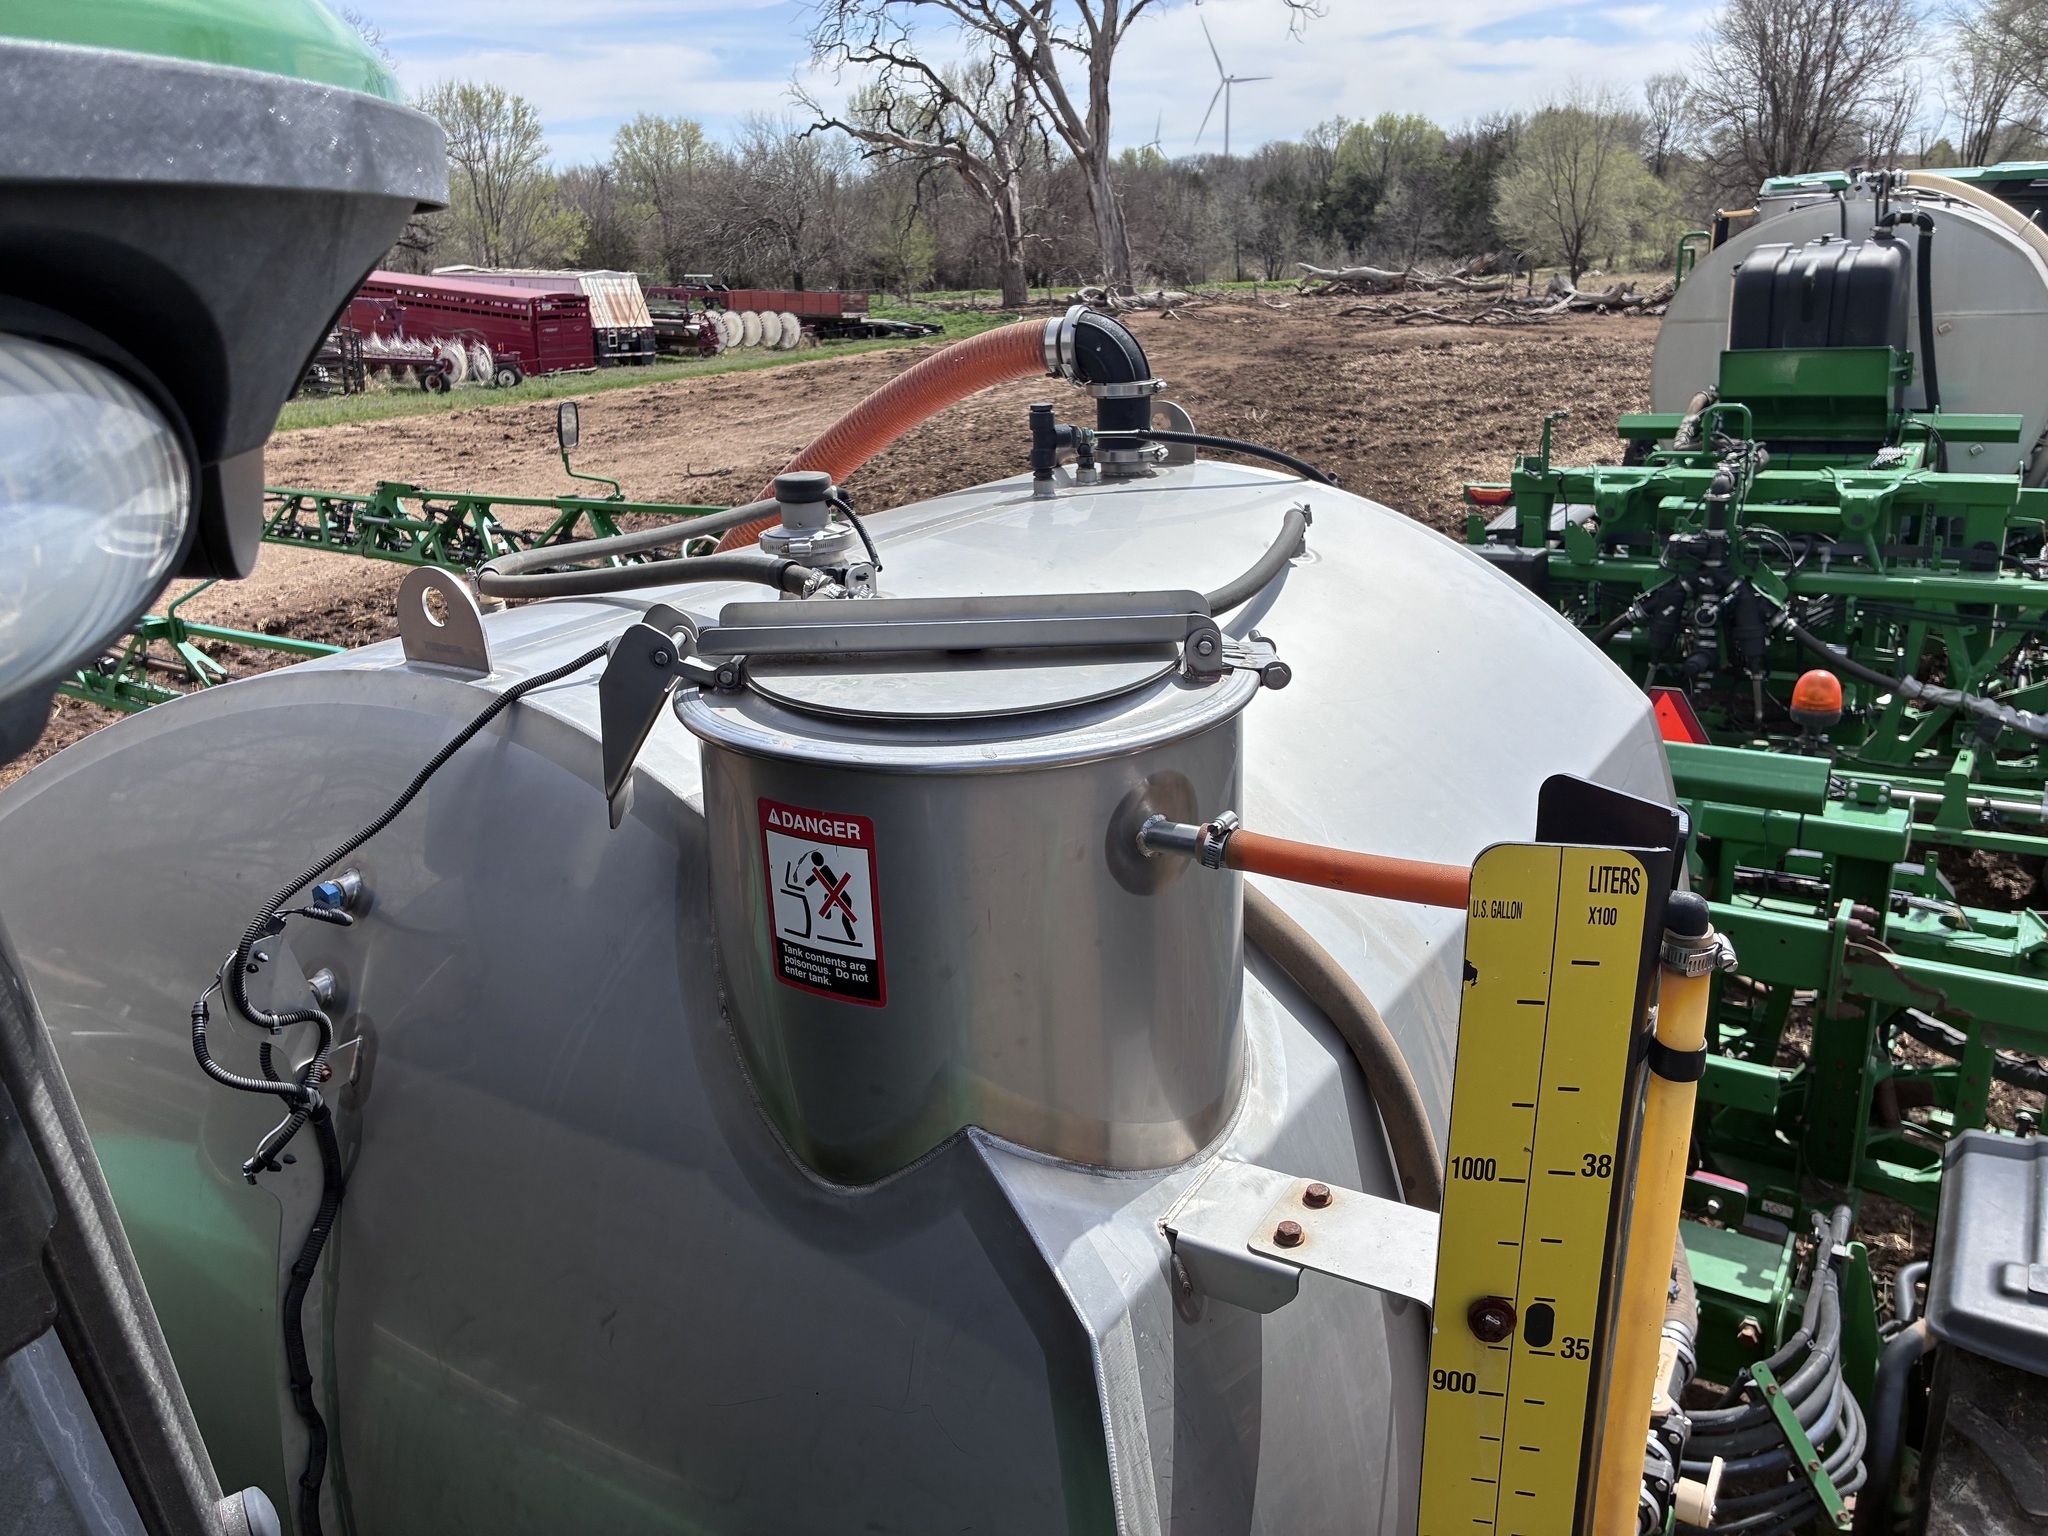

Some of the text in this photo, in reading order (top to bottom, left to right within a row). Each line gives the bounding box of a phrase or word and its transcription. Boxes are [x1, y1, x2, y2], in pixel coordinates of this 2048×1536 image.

[782, 811, 861, 840] DANGER
[1588, 865, 1641, 895] LITERS
[1472, 900, 1523, 920] U.S. GALLON
[1588, 906, 1617, 926] X100
[783, 942, 867, 972] Tank contents are
[784, 955, 869, 983] poisonous. Do not
[785, 965, 832, 986] enter tank.
[1451, 1156, 1496, 1182] 1000
[1581, 1153, 1612, 1178] 38
[1560, 1336, 1590, 1361] 35
[1432, 1369, 1477, 1394] 900
